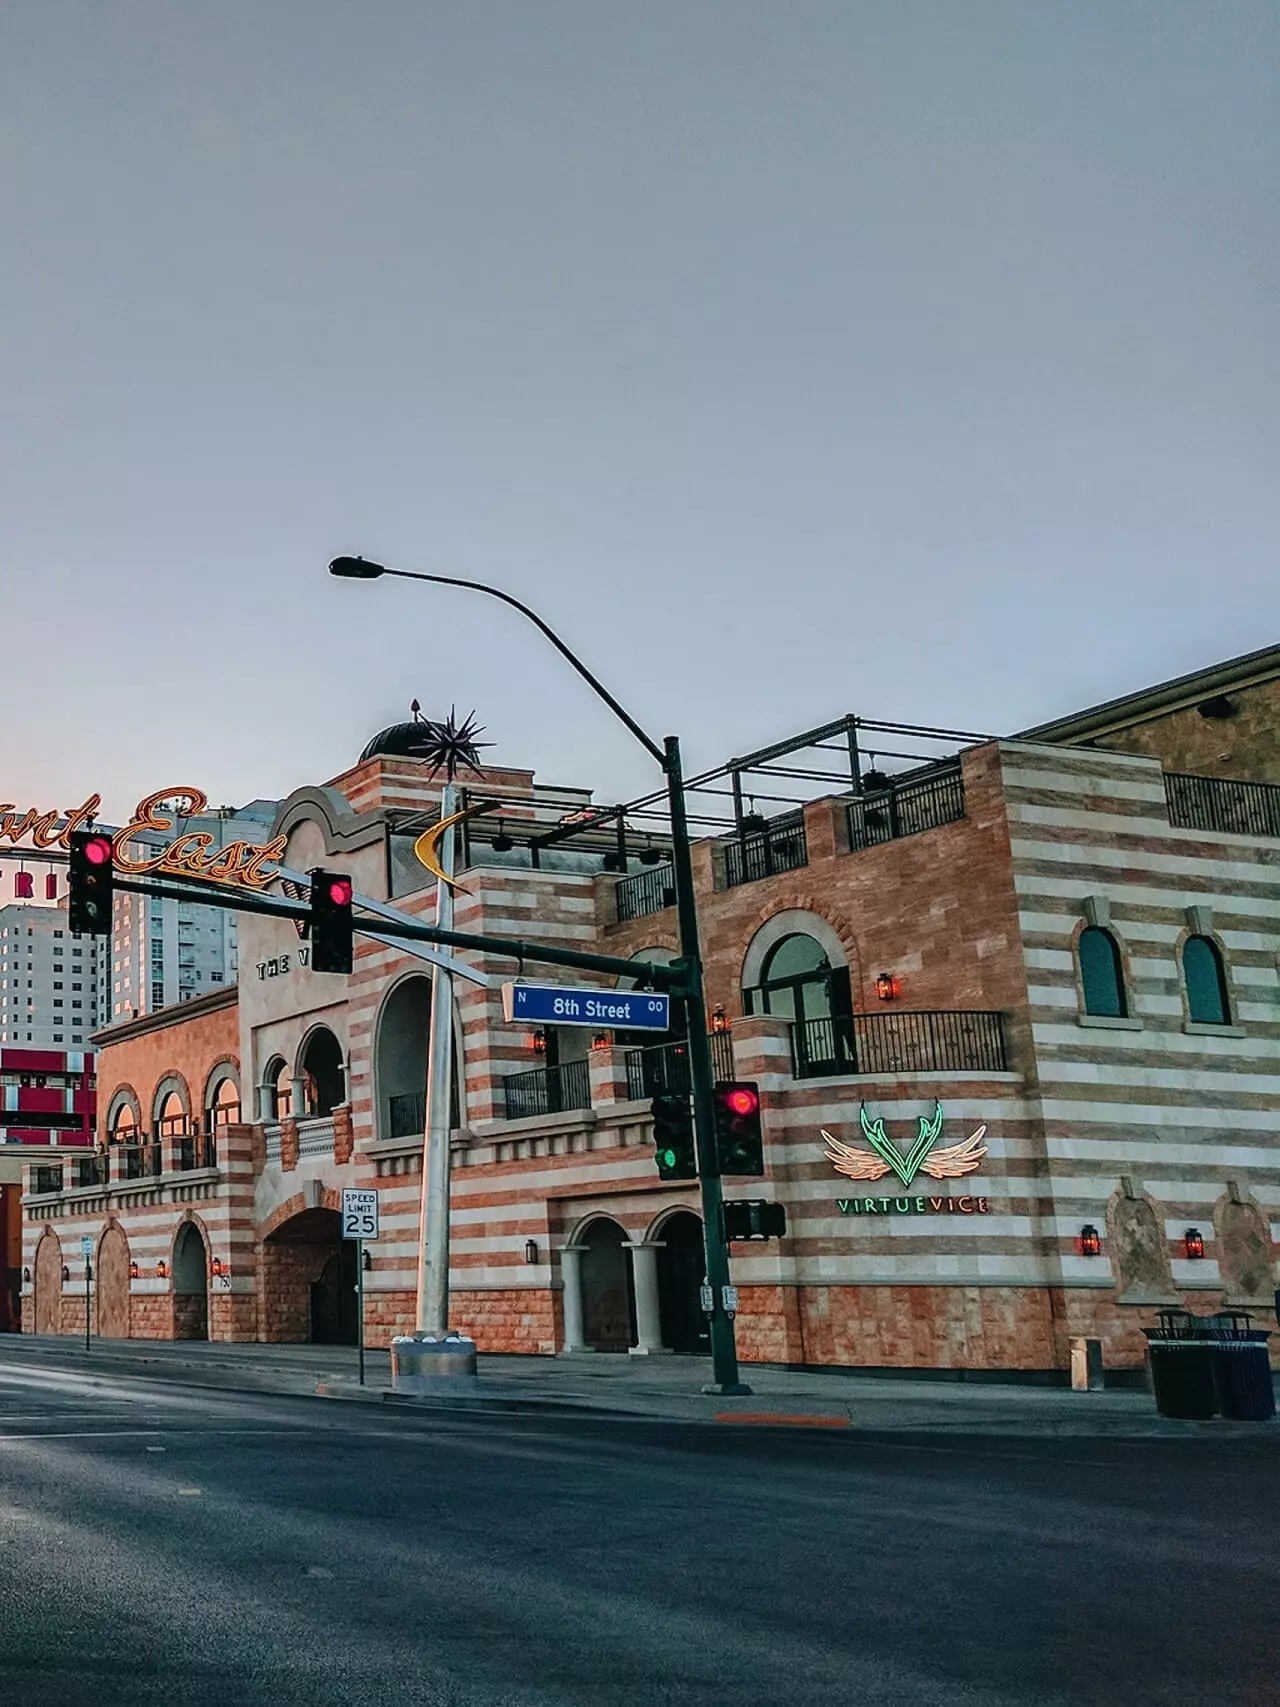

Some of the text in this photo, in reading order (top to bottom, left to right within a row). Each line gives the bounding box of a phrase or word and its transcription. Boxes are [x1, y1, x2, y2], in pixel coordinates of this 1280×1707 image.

[109, 786, 289, 886] East
[256, 947, 310, 981] THE V
[518, 991, 527, 1003] N
[553, 997, 580, 1016] 8th
[585, 999, 631, 1019] Street
[345, 1193, 376, 1203] SPEED
[348, 1204, 372, 1213] LIMIT
[346, 1214, 375, 1234] 25
